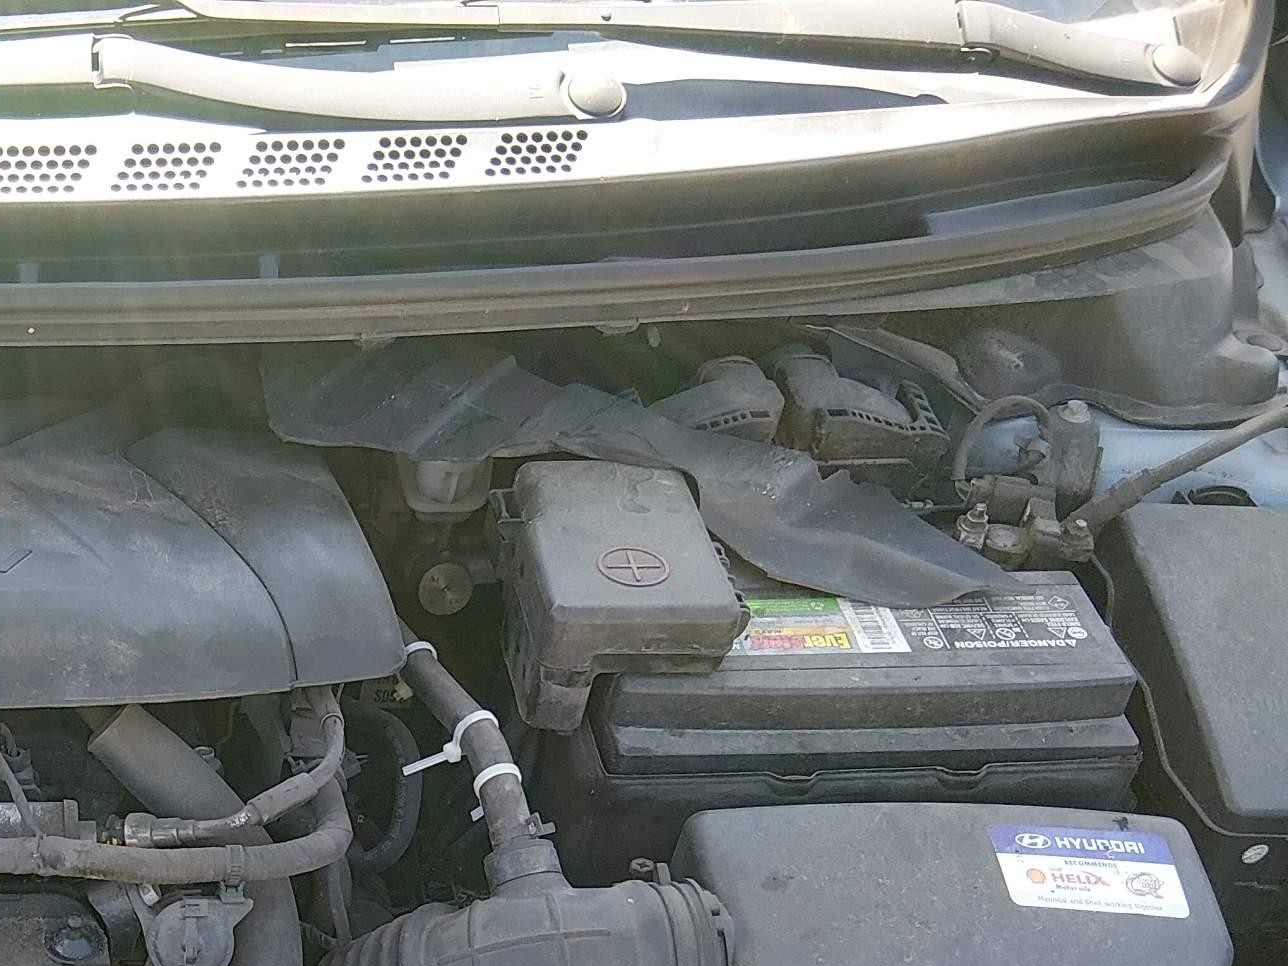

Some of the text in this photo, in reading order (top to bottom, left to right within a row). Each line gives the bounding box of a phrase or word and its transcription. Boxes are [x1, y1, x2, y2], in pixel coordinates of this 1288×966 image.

[749, 631, 852, 650] EverStart
[953, 639, 1067, 649] DANGER/POISON
[1055, 836, 1145, 854] HYUNDAI
[1051, 870, 1110, 887] HELIX
